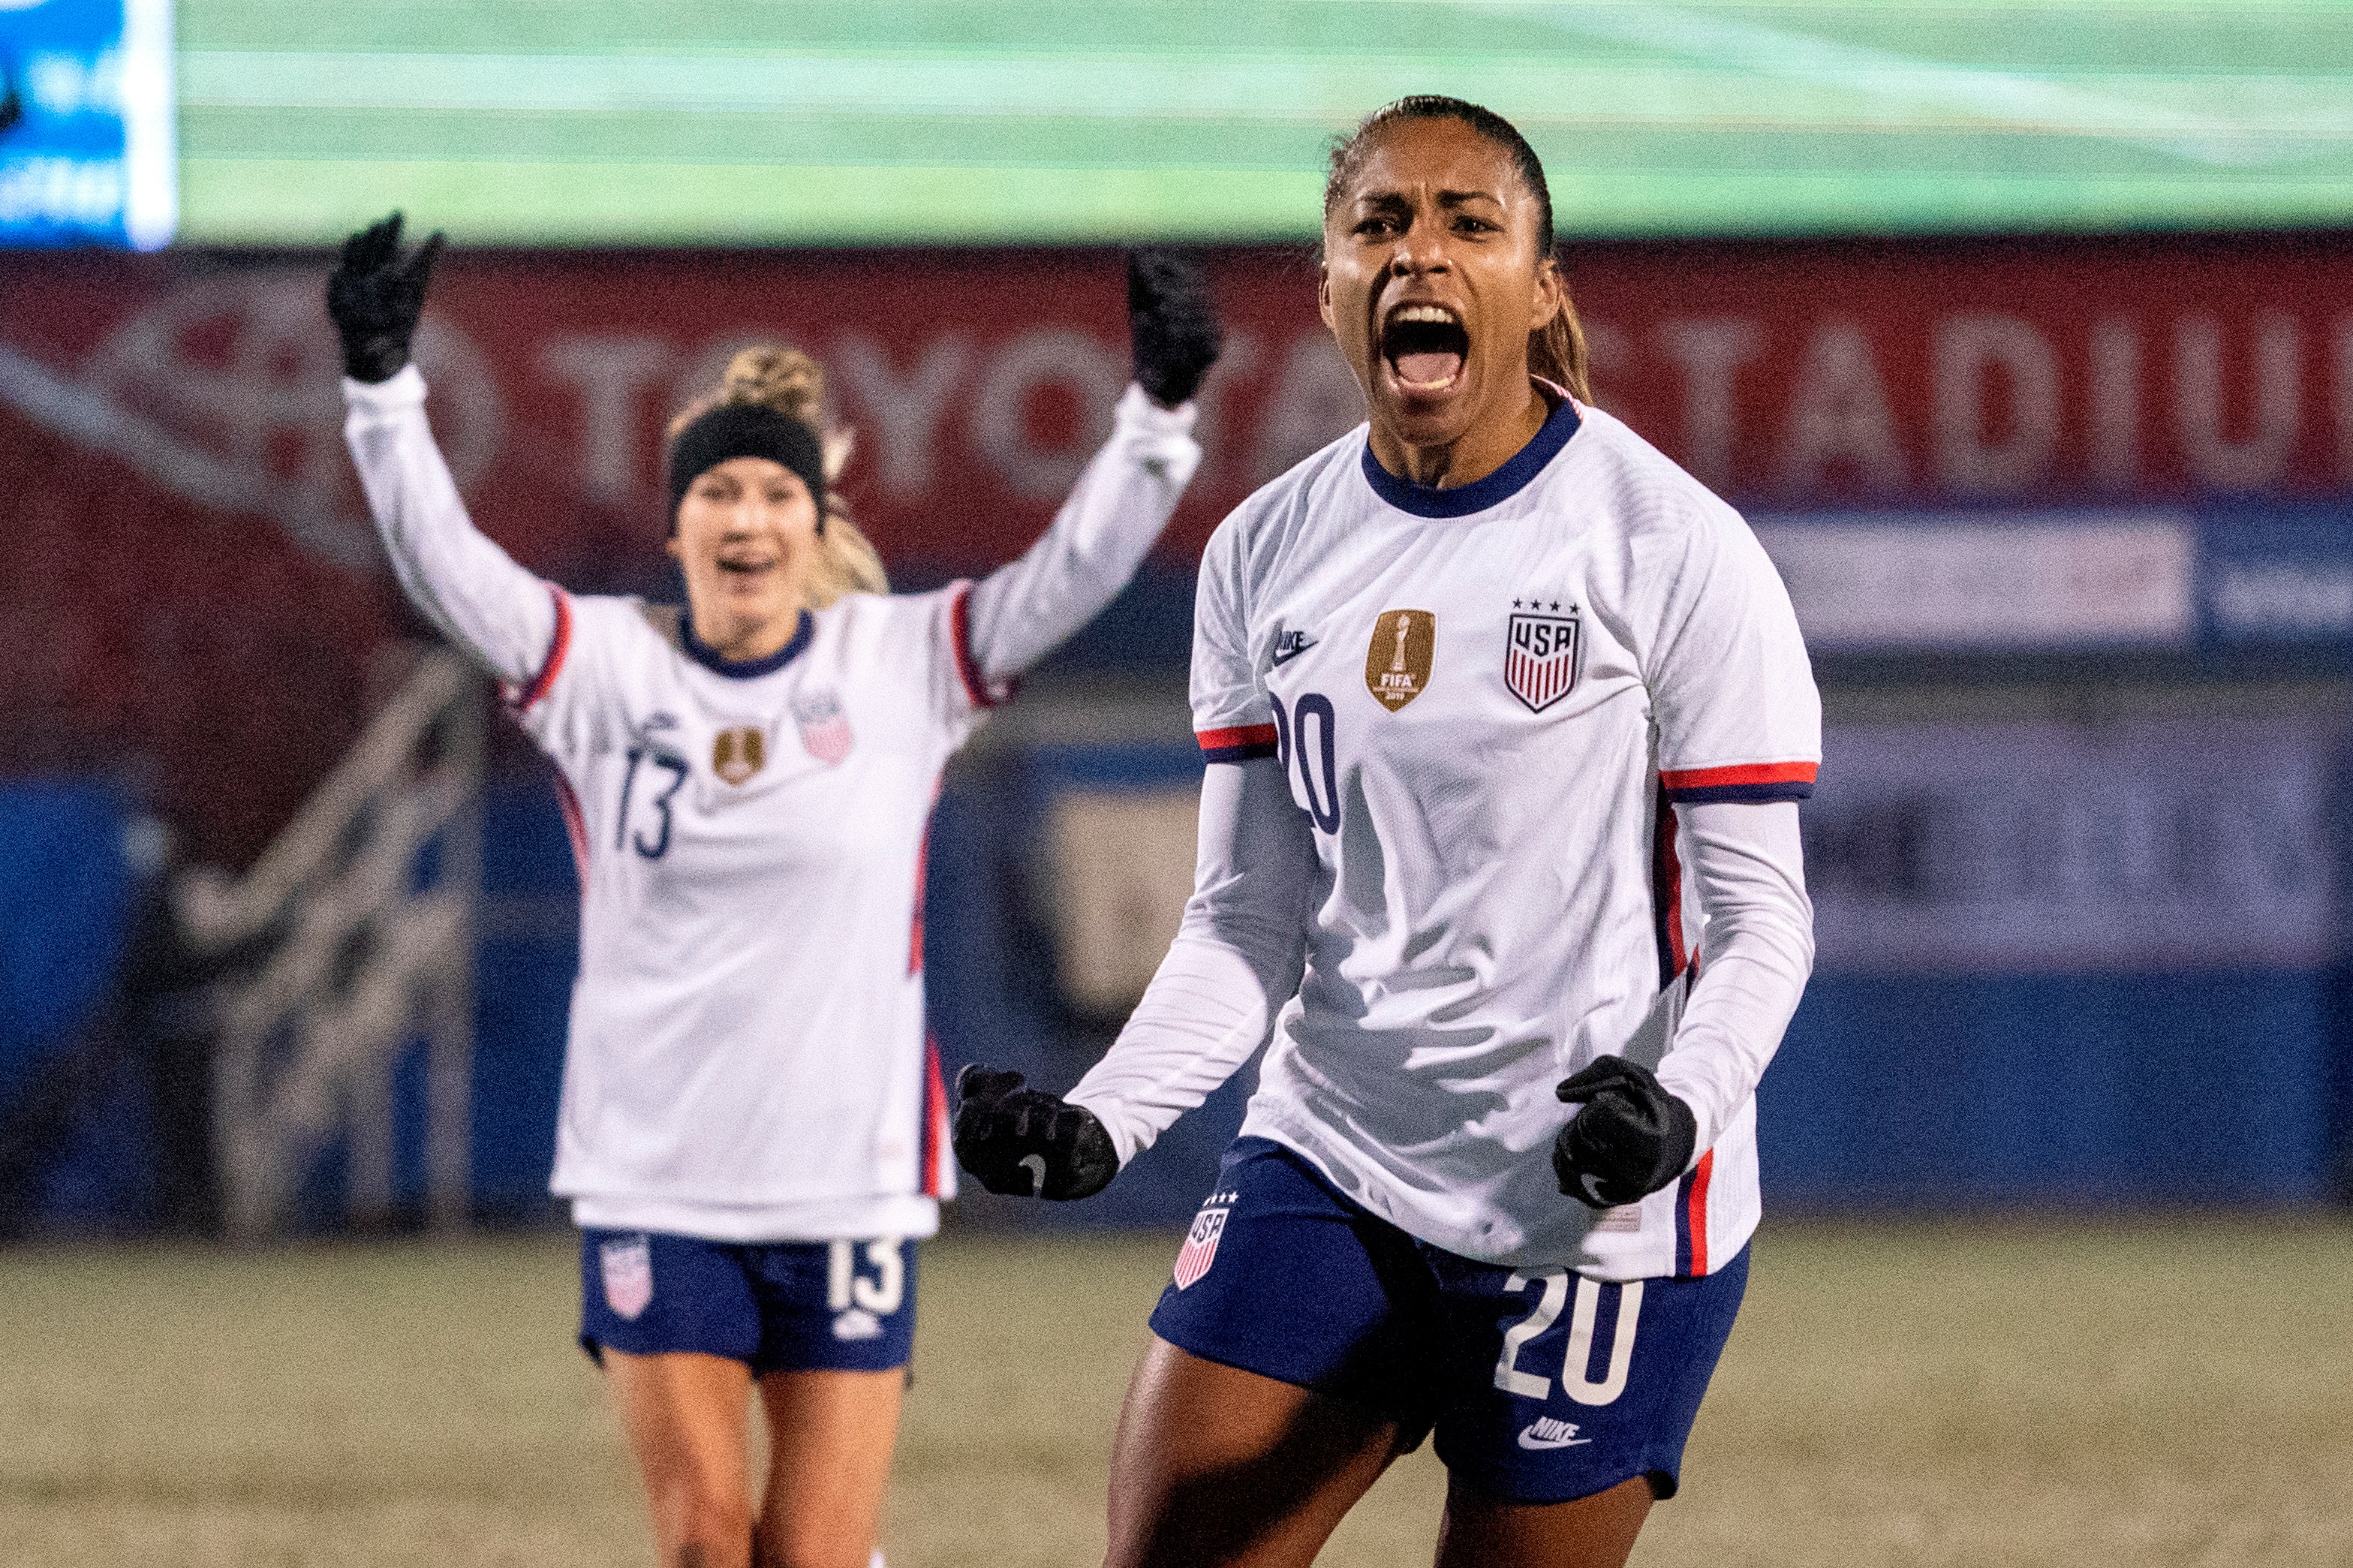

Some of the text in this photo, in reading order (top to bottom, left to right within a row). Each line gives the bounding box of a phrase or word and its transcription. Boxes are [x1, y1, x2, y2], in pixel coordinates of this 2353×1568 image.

[534, 314, 2353, 498] TYOA TADIU
[1515, 621, 1572, 658] USA
[1381, 673, 1413, 687] FIFA
[1271, 692, 1341, 835] 0
[613, 746, 692, 862] 13
[1191, 1213, 1226, 1244] USA
[827, 1235, 903, 1315] 13
[1494, 1267, 1644, 1407] 20
[1529, 1415, 1581, 1442] NIKE
